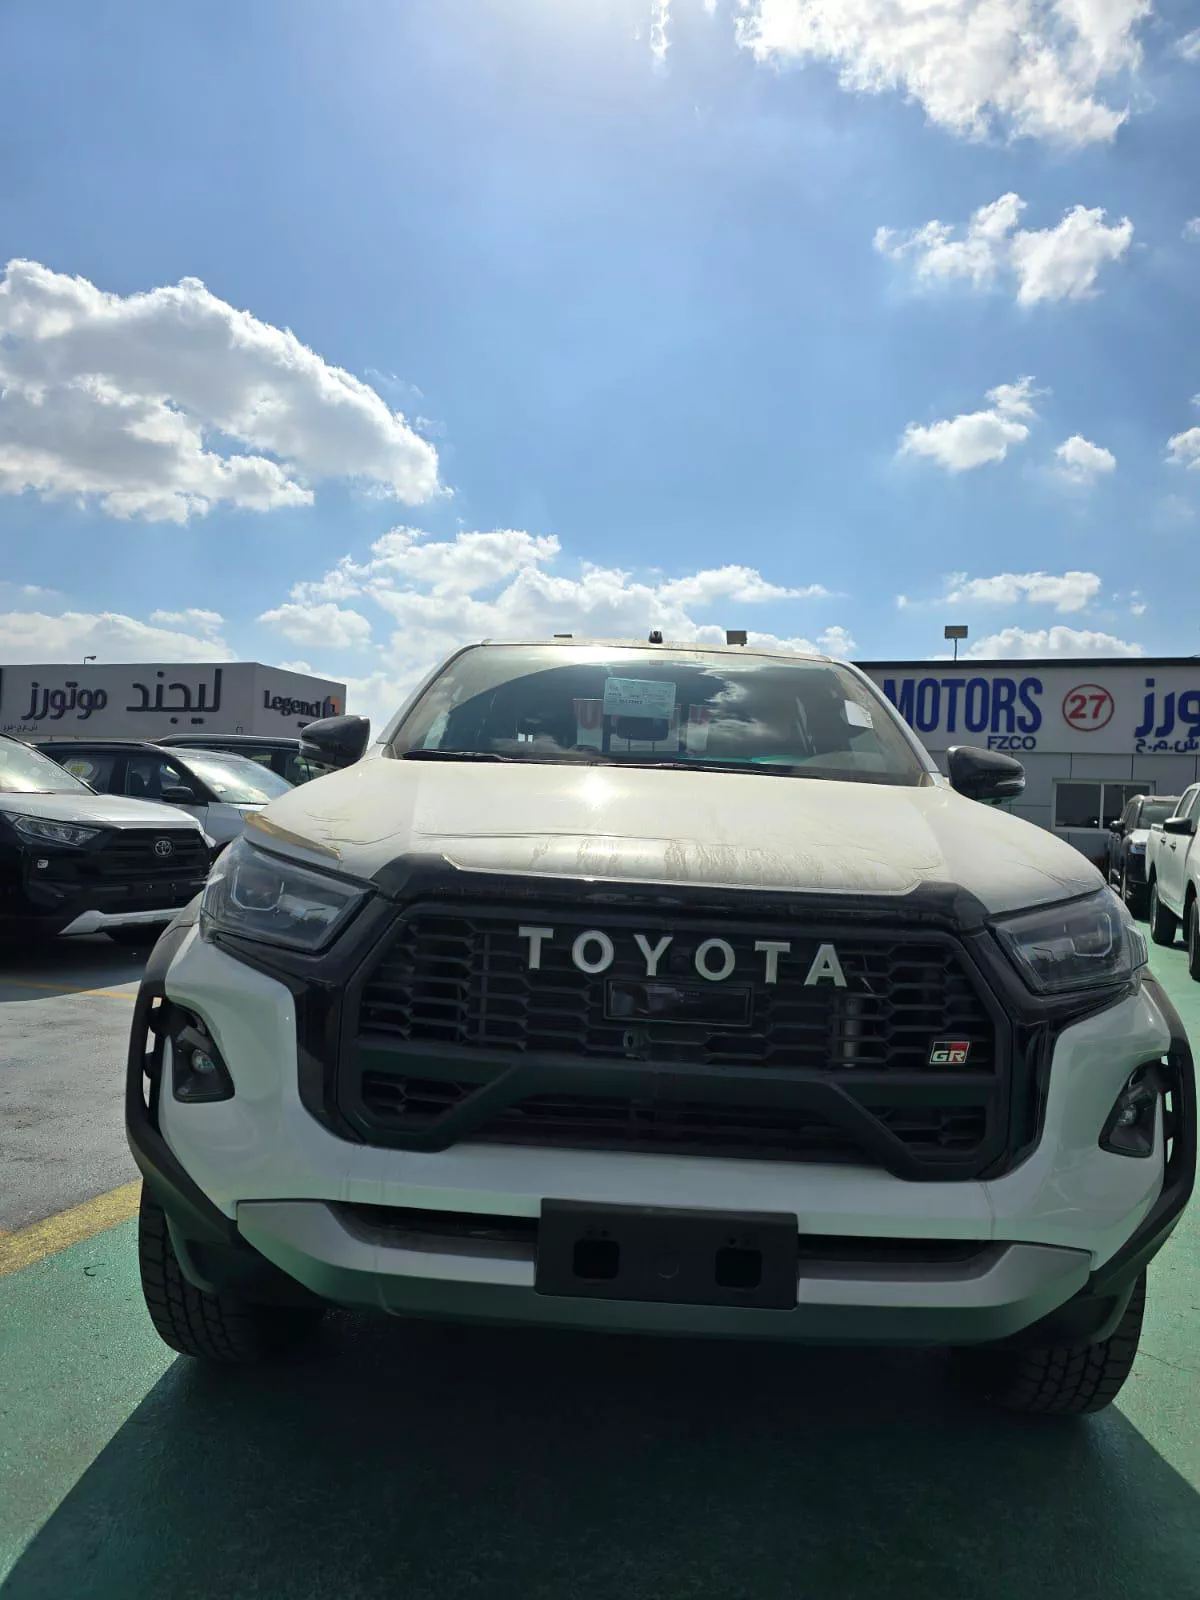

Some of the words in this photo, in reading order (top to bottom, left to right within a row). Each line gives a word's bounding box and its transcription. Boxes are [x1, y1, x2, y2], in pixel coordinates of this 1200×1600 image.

[21, 681, 107, 720] موتورز
[126, 668, 223, 725] ليجند
[264, 690, 321, 717] Legend
[884, 677, 1043, 733] MOTORS
[1069, 694, 1107, 719] 27
[987, 736, 1037, 750] FZCO
[518, 925, 848, 988] TOYOTA
[932, 1050, 966, 1062] GR
